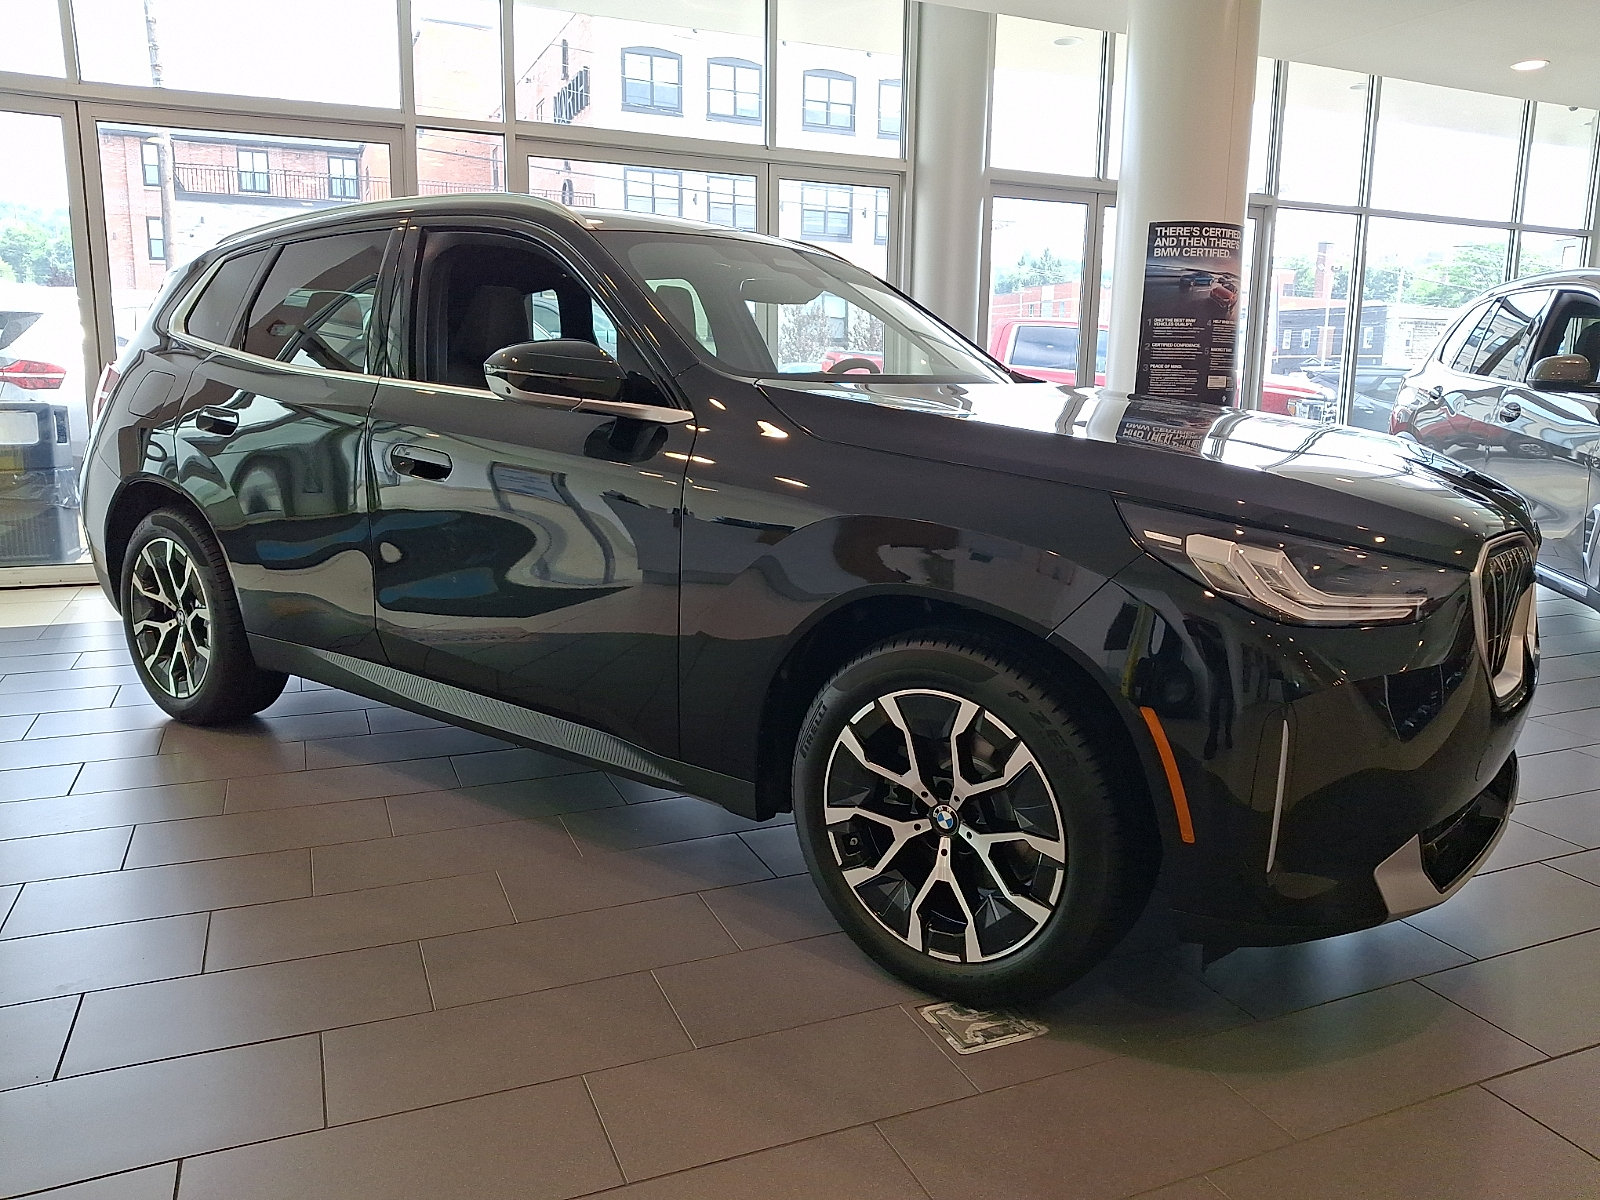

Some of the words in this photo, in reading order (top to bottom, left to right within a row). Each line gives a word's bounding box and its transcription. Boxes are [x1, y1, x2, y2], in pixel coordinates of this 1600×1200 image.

[1155, 226, 1200, 237] THERE'S
[1202, 227, 1241, 240] CERTIFIED
[1154, 237, 1177, 247] AND
[1179, 237, 1208, 247] THEN
[1209, 239, 1240, 250] THERE'S
[1154, 247, 1180, 257] BMW
[1182, 248, 1232, 259] CERTIFIED.
[799, 701, 828, 759] PIRELLI
